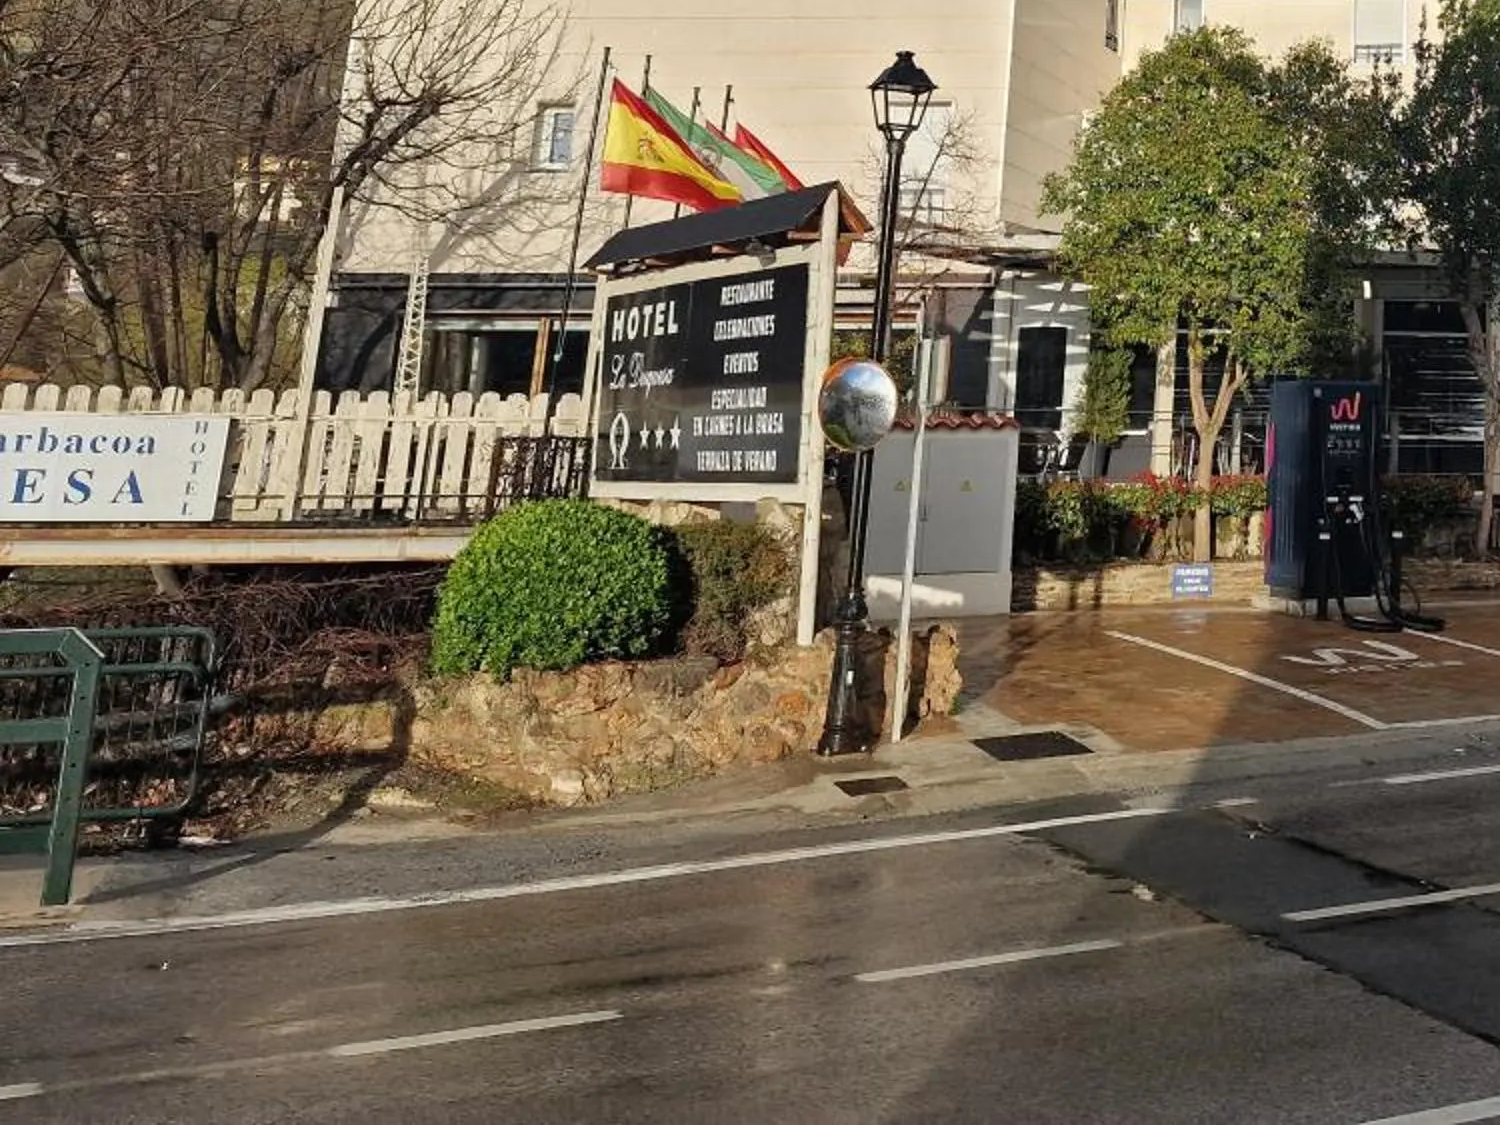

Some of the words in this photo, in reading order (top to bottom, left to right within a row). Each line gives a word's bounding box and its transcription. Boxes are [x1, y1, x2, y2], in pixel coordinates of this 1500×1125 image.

[721, 279, 775, 306] RESTAURANTE
[612, 300, 679, 342] HOTEL
[713, 315, 776, 342] CELEBRACIONES
[723, 351, 759, 375] EVENTOS
[711, 387, 767, 410] ESPECIALIDAD
[693, 416, 703, 437] EN
[704, 415, 734, 436] CARNES
[735, 414, 742, 435] A
[743, 414, 754, 435] LA
[755, 412, 784, 435] BRASA
[181, 421, 209, 516] HOTEL
[697, 450, 730, 472] TERRAZA
[731, 450, 743, 472] DE
[744, 450, 777, 472] VERANO
[8, 468, 144, 505] ESA
